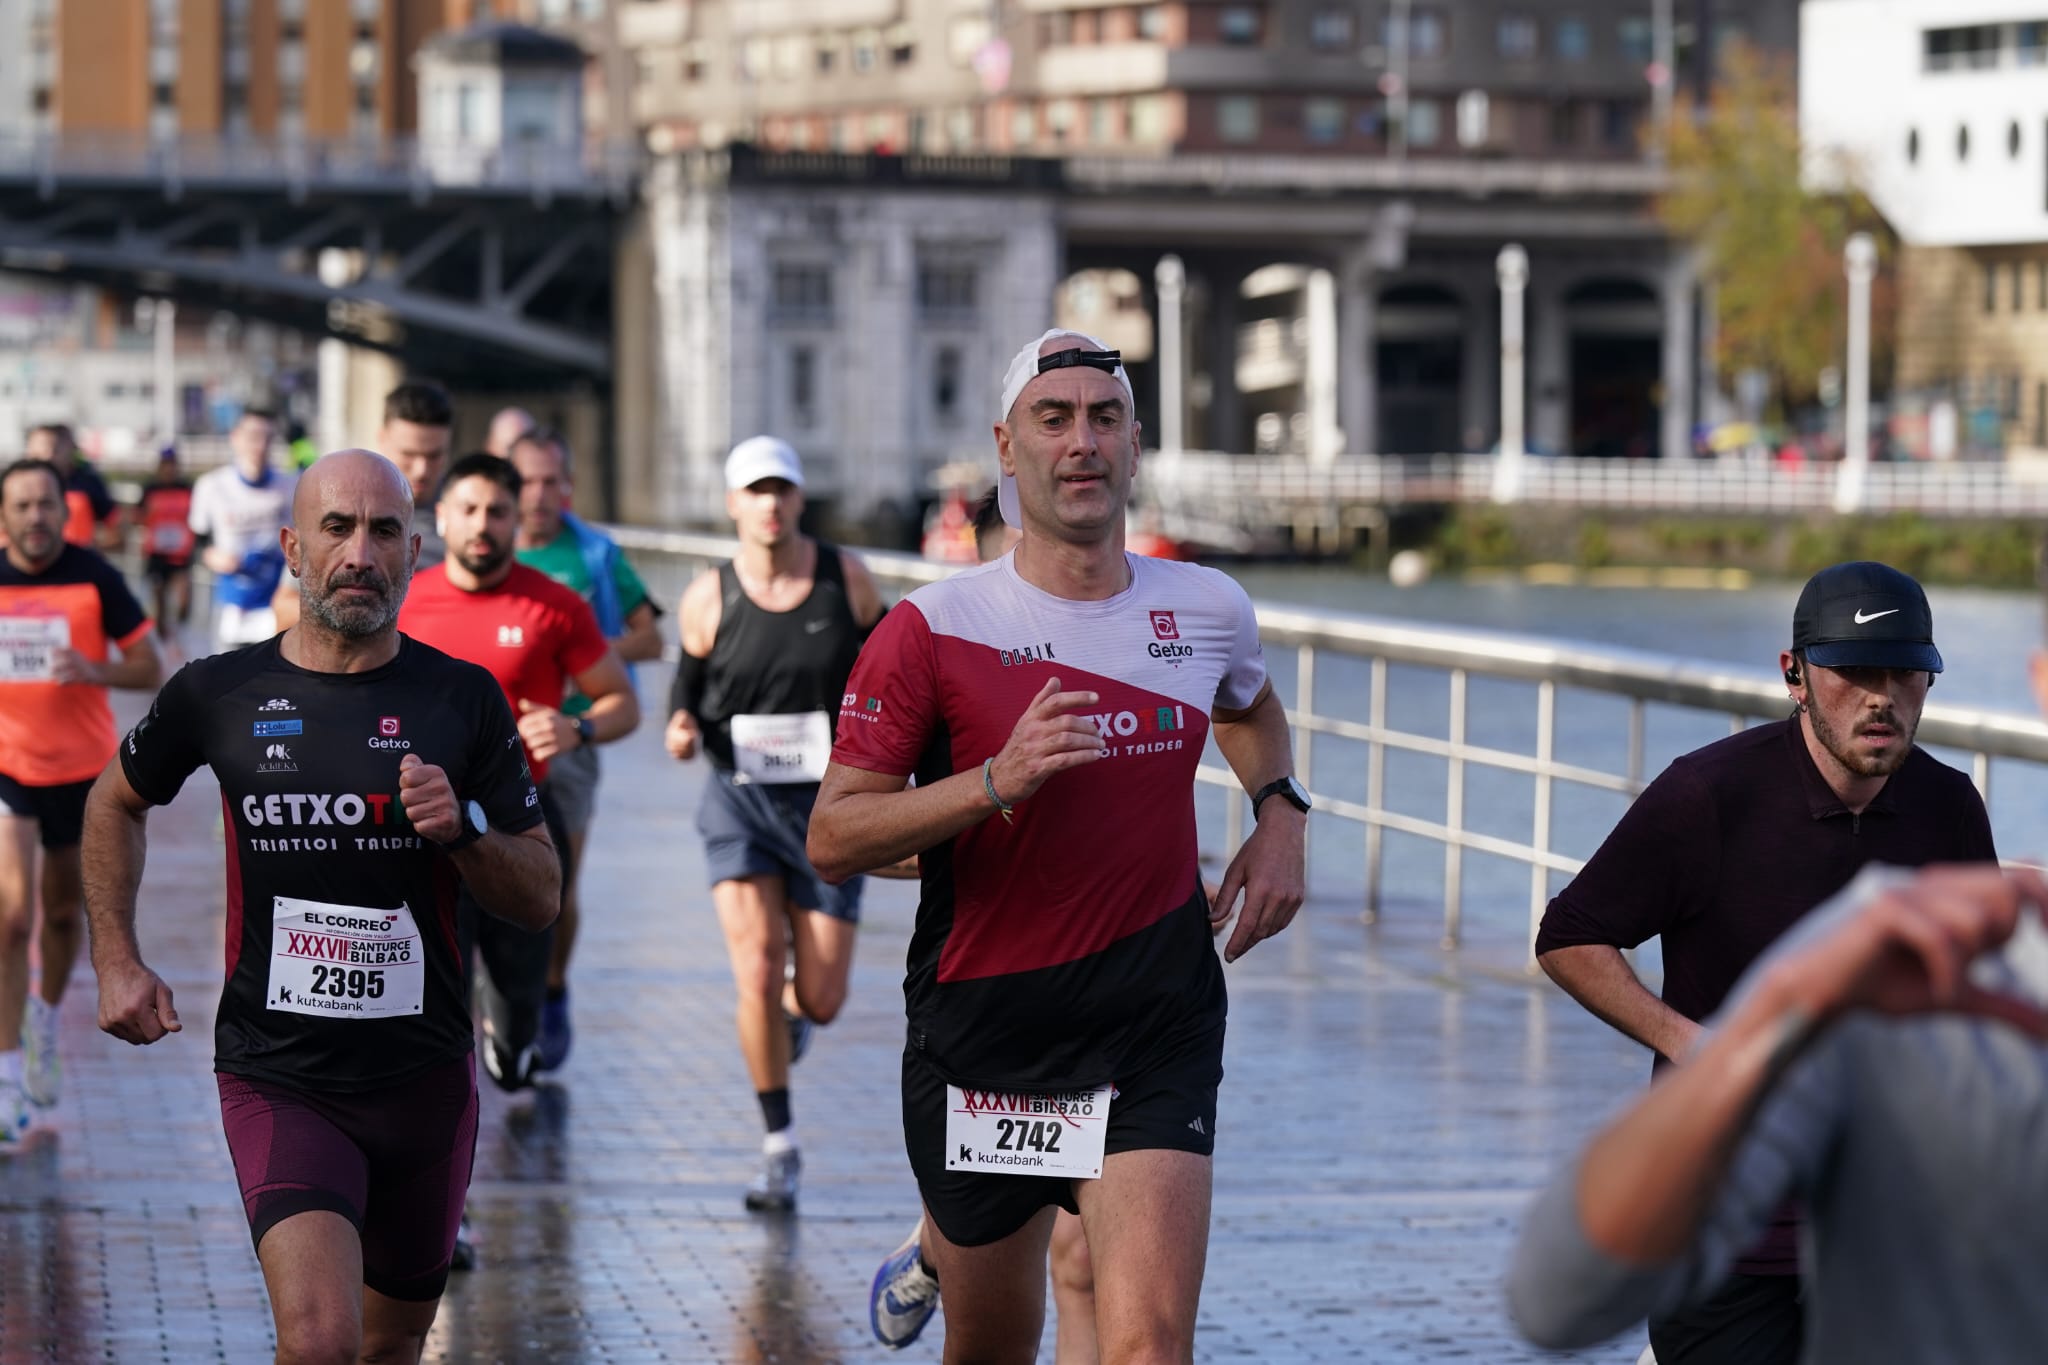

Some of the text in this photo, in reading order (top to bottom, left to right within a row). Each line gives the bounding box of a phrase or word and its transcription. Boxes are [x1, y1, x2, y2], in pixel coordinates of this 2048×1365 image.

[1001, 642, 1055, 666] GOBIK
[1148, 642, 1192, 658] Getxo
[368, 737, 411, 749] Getxo
[251, 838, 337, 852] TRIATLOI
[304, 912, 392, 931] EL CORREO
[288, 931, 348, 961] XXXVII
[351, 940, 411, 952] SANTURCE
[350, 950, 411, 964] BILBAO
[310, 964, 385, 999] 2395
[297, 994, 364, 1012] kutxabank
[1033, 1101, 1093, 1115] BILBAO
[996, 1118, 1063, 1153] 2742
[978, 1152, 1044, 1167] kutxabank
